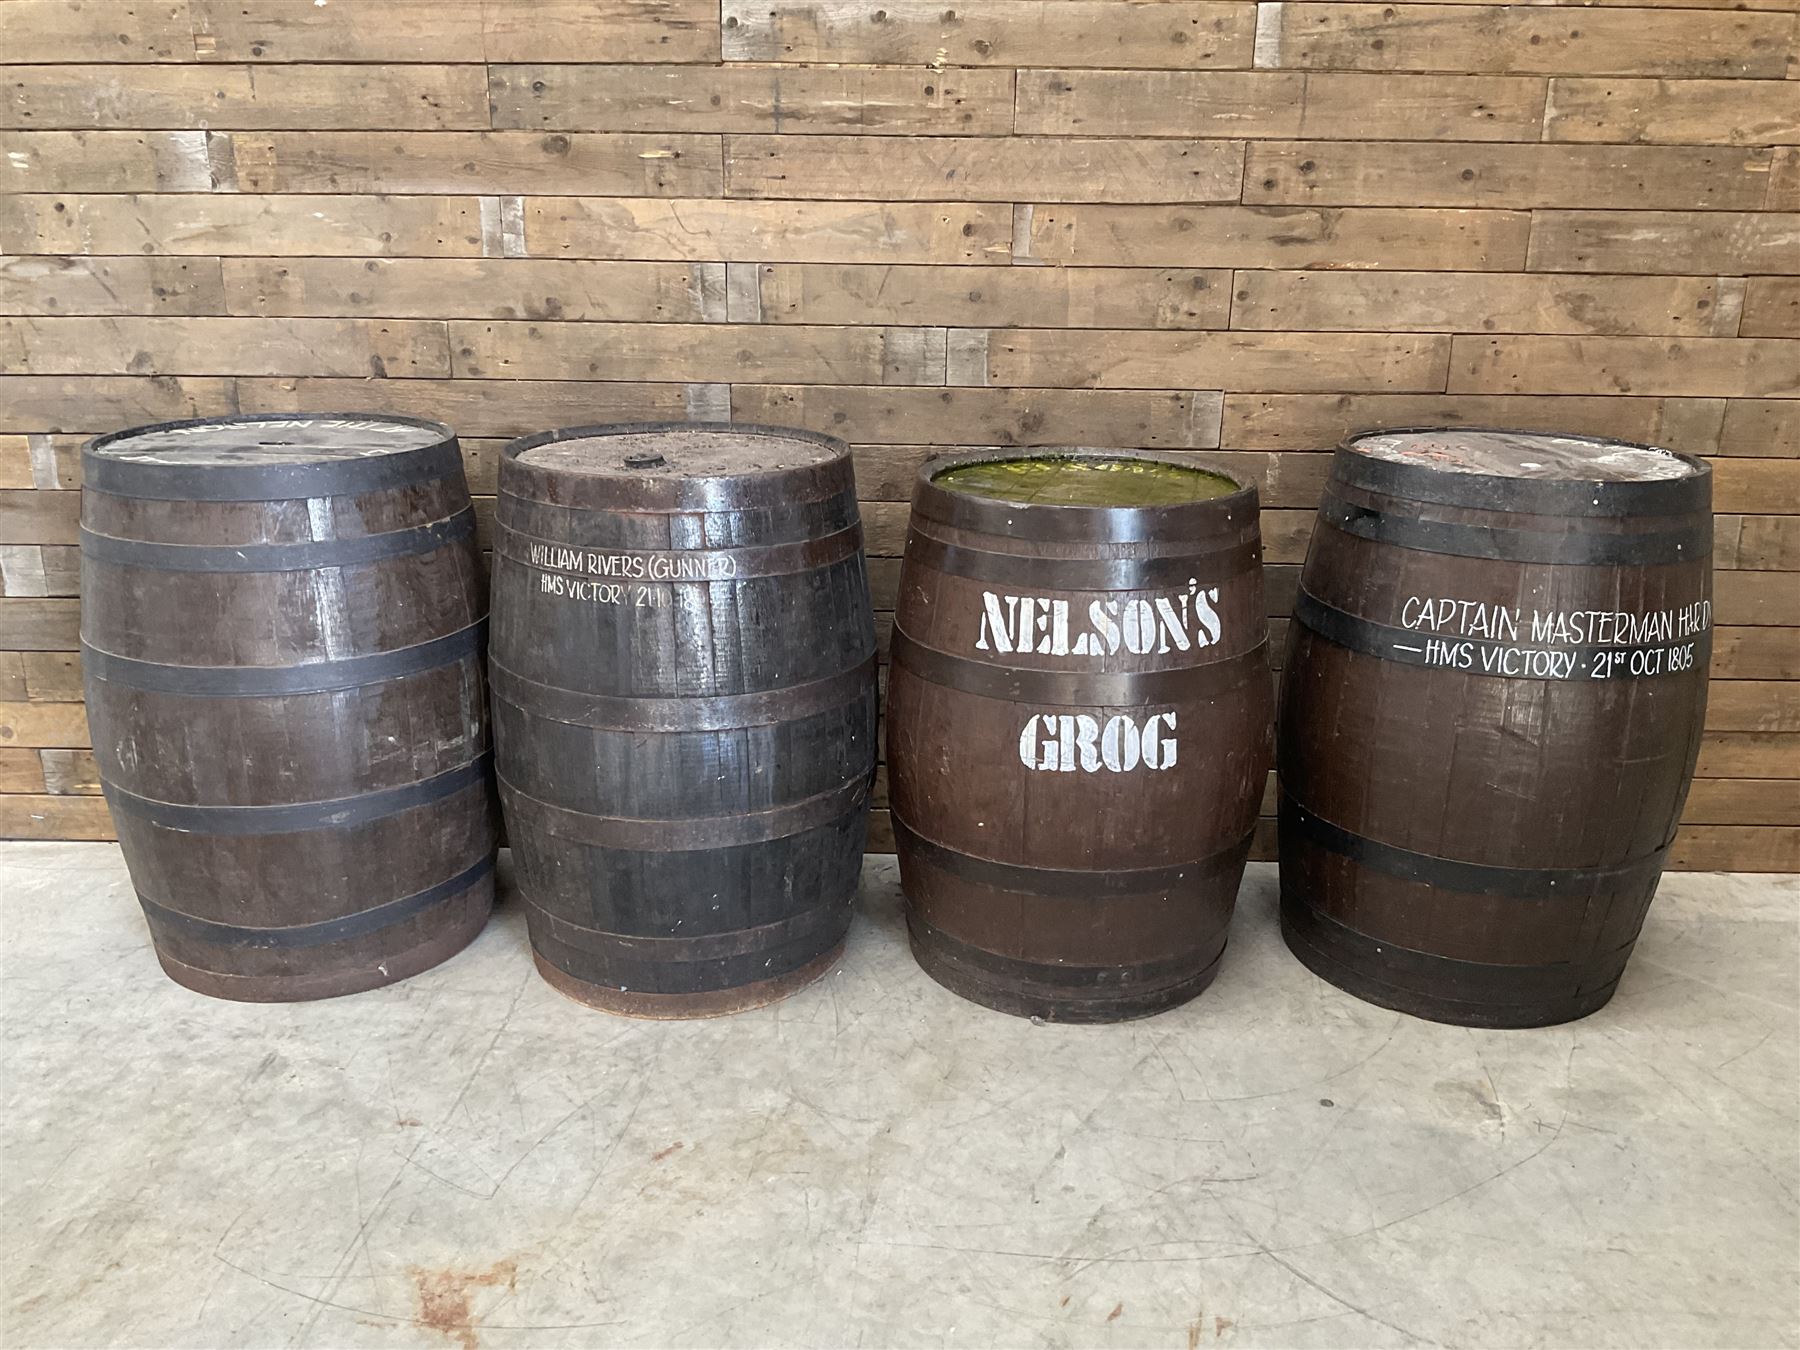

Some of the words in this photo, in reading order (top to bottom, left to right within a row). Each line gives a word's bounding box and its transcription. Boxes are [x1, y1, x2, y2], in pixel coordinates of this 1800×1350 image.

[529, 541, 584, 573] WILLIAM
[587, 553, 645, 579] RIVERS
[647, 554, 738, 580] (GUNNER)
[540, 572, 565, 596] HMS
[565, 578, 631, 605] VICTORY
[974, 577, 1222, 657] NELSON'S
[1530, 609, 1674, 645] MASTERMAN
[1480, 645, 1577, 679] VICTORY
[1590, 650, 1627, 679] 21ST
[1630, 647, 1665, 676] OCT
[1667, 642, 1695, 672] 1805
[1018, 711, 1179, 773] GROG
